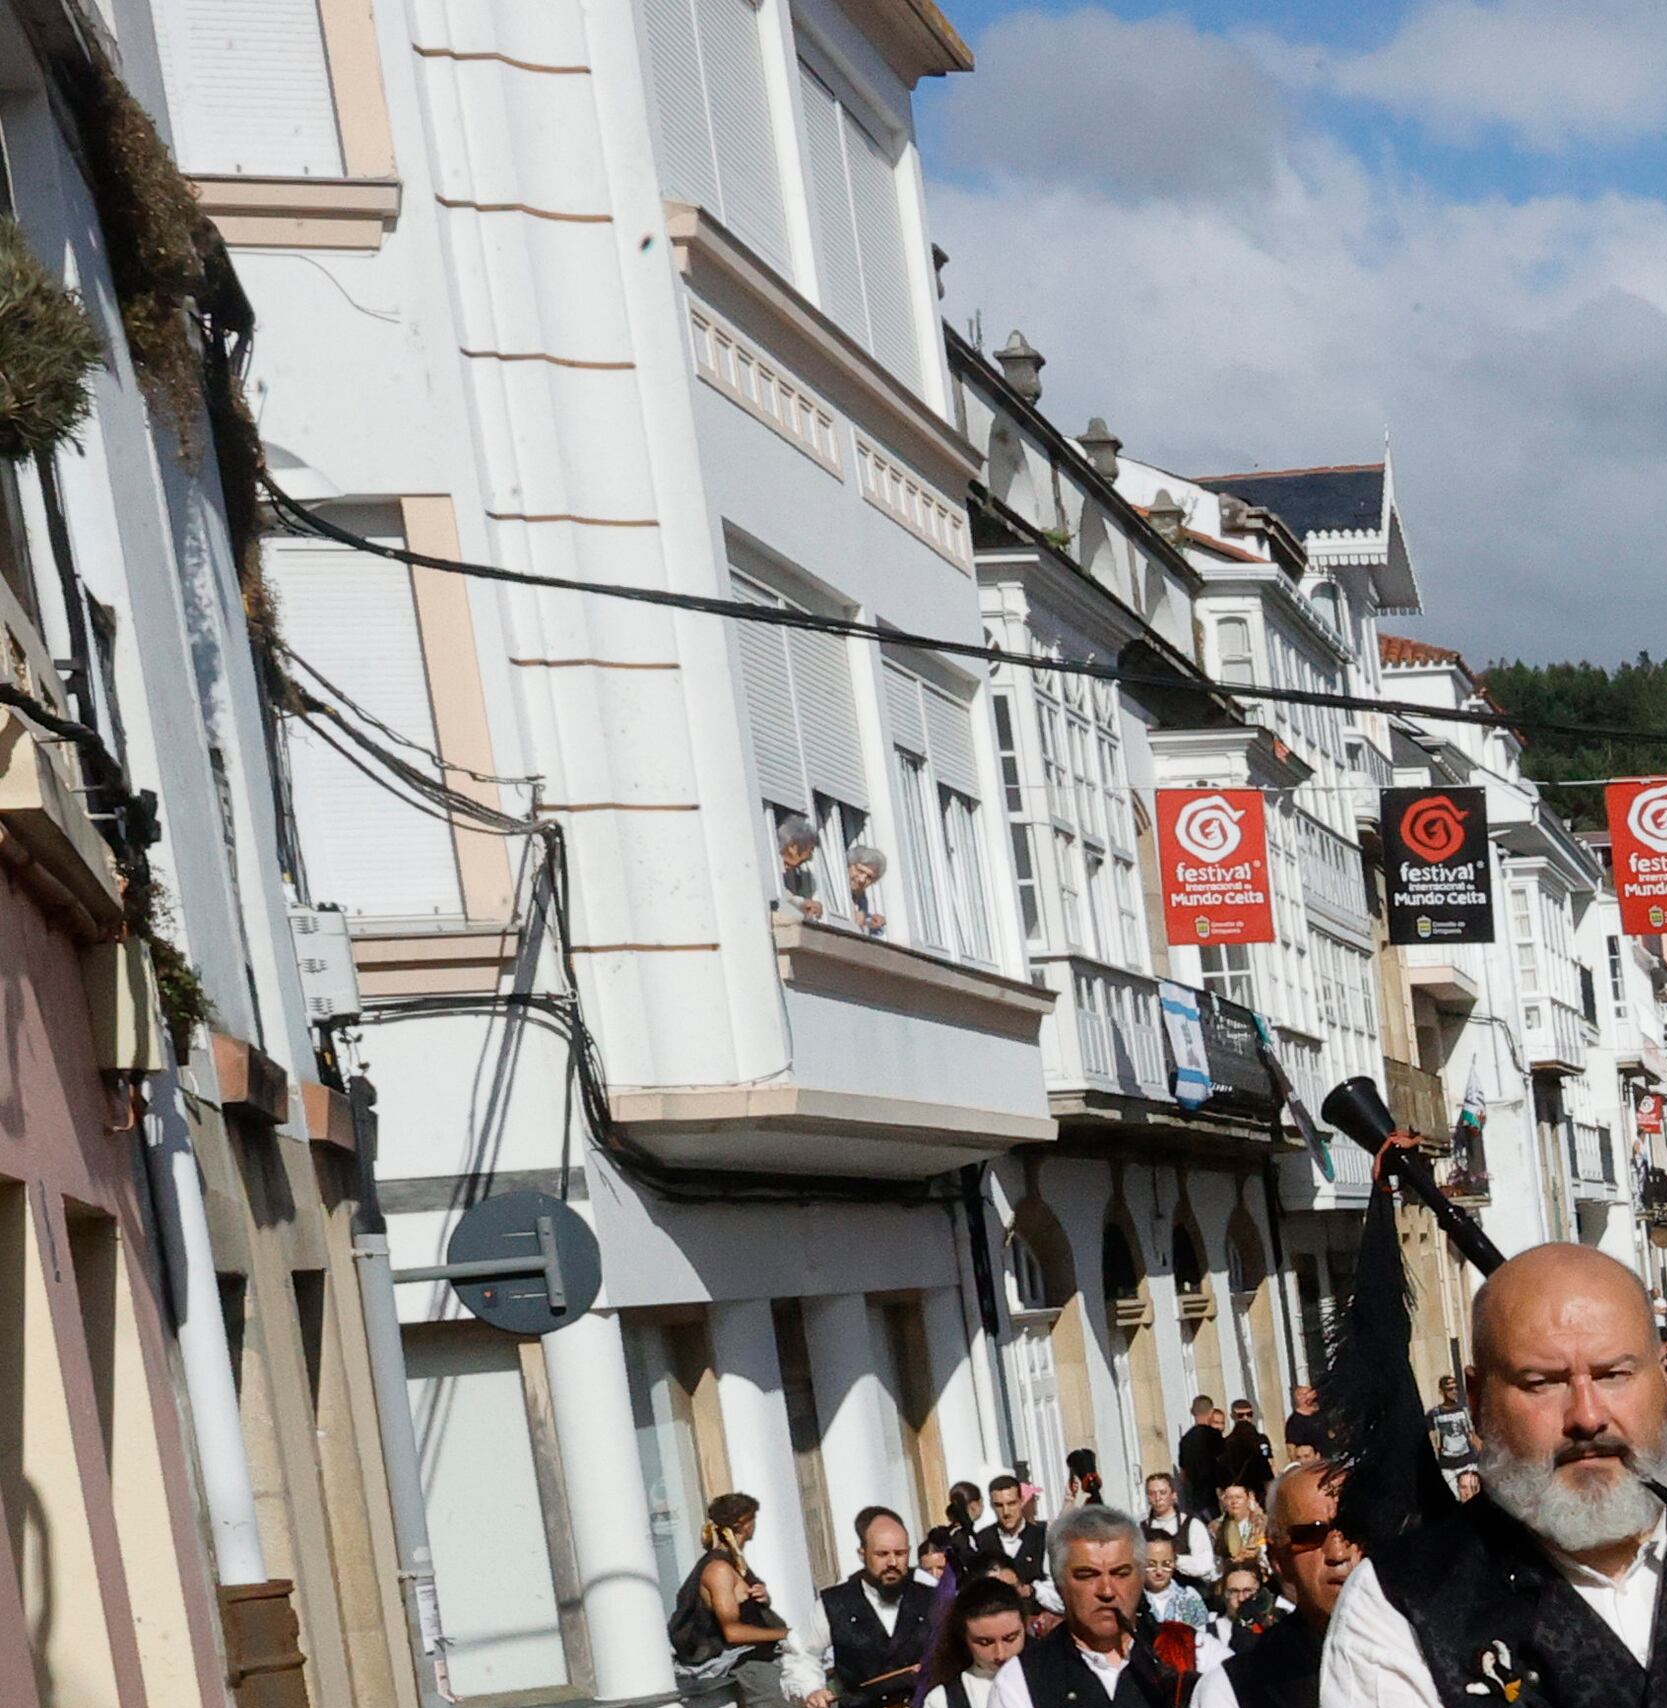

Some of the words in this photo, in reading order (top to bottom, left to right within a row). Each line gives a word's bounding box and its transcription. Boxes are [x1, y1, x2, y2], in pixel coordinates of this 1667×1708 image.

[1176, 862, 1251, 882] festival
[1400, 861, 1474, 882] festival
[1171, 892, 1222, 907] Mundo
[1224, 891, 1265, 904] Celta
[1394, 891, 1445, 907] Mundo
[1447, 891, 1486, 904] Celta
